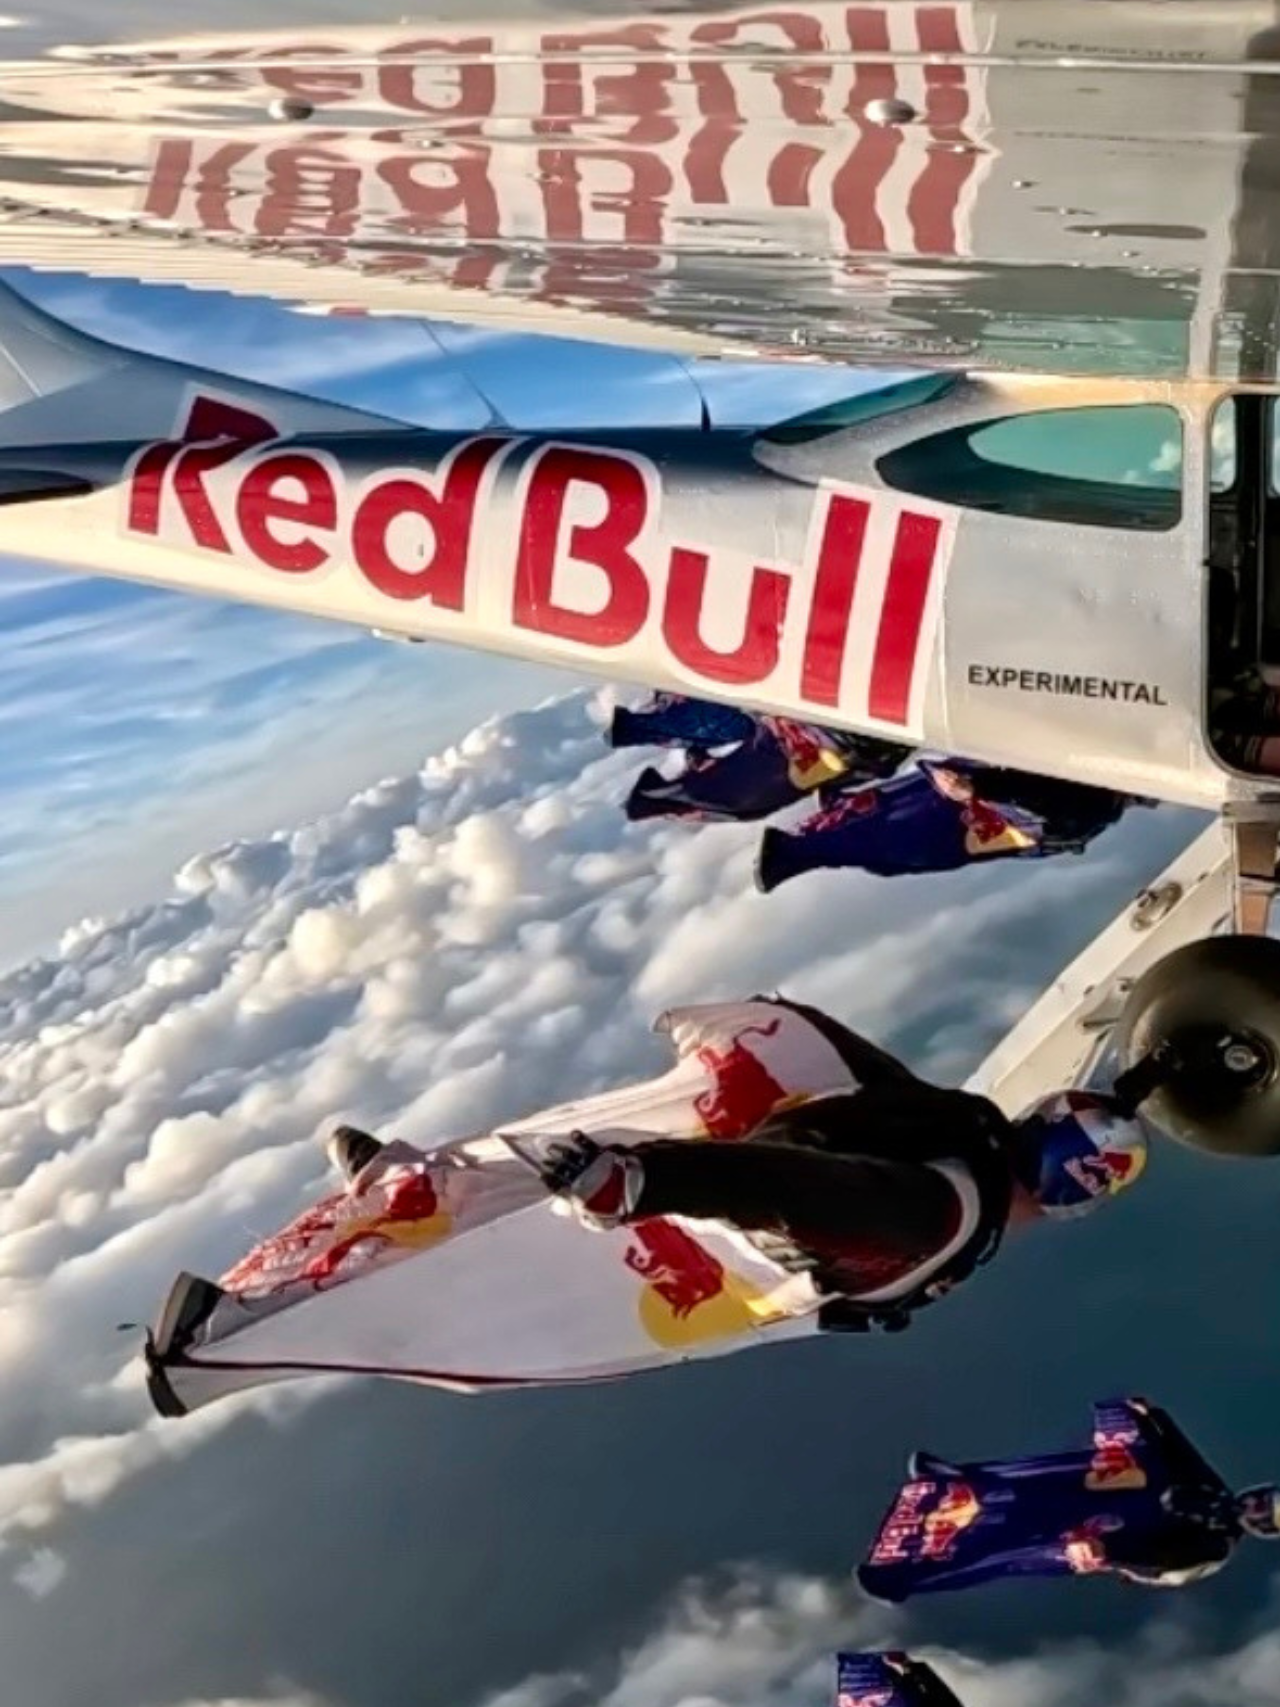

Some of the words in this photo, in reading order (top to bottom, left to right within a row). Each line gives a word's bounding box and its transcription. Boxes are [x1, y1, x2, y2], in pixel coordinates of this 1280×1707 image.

[127, 396, 508, 613] Red
[511, 445, 944, 726] Bull
[968, 664, 1168, 706] EXPERIMENTAL
